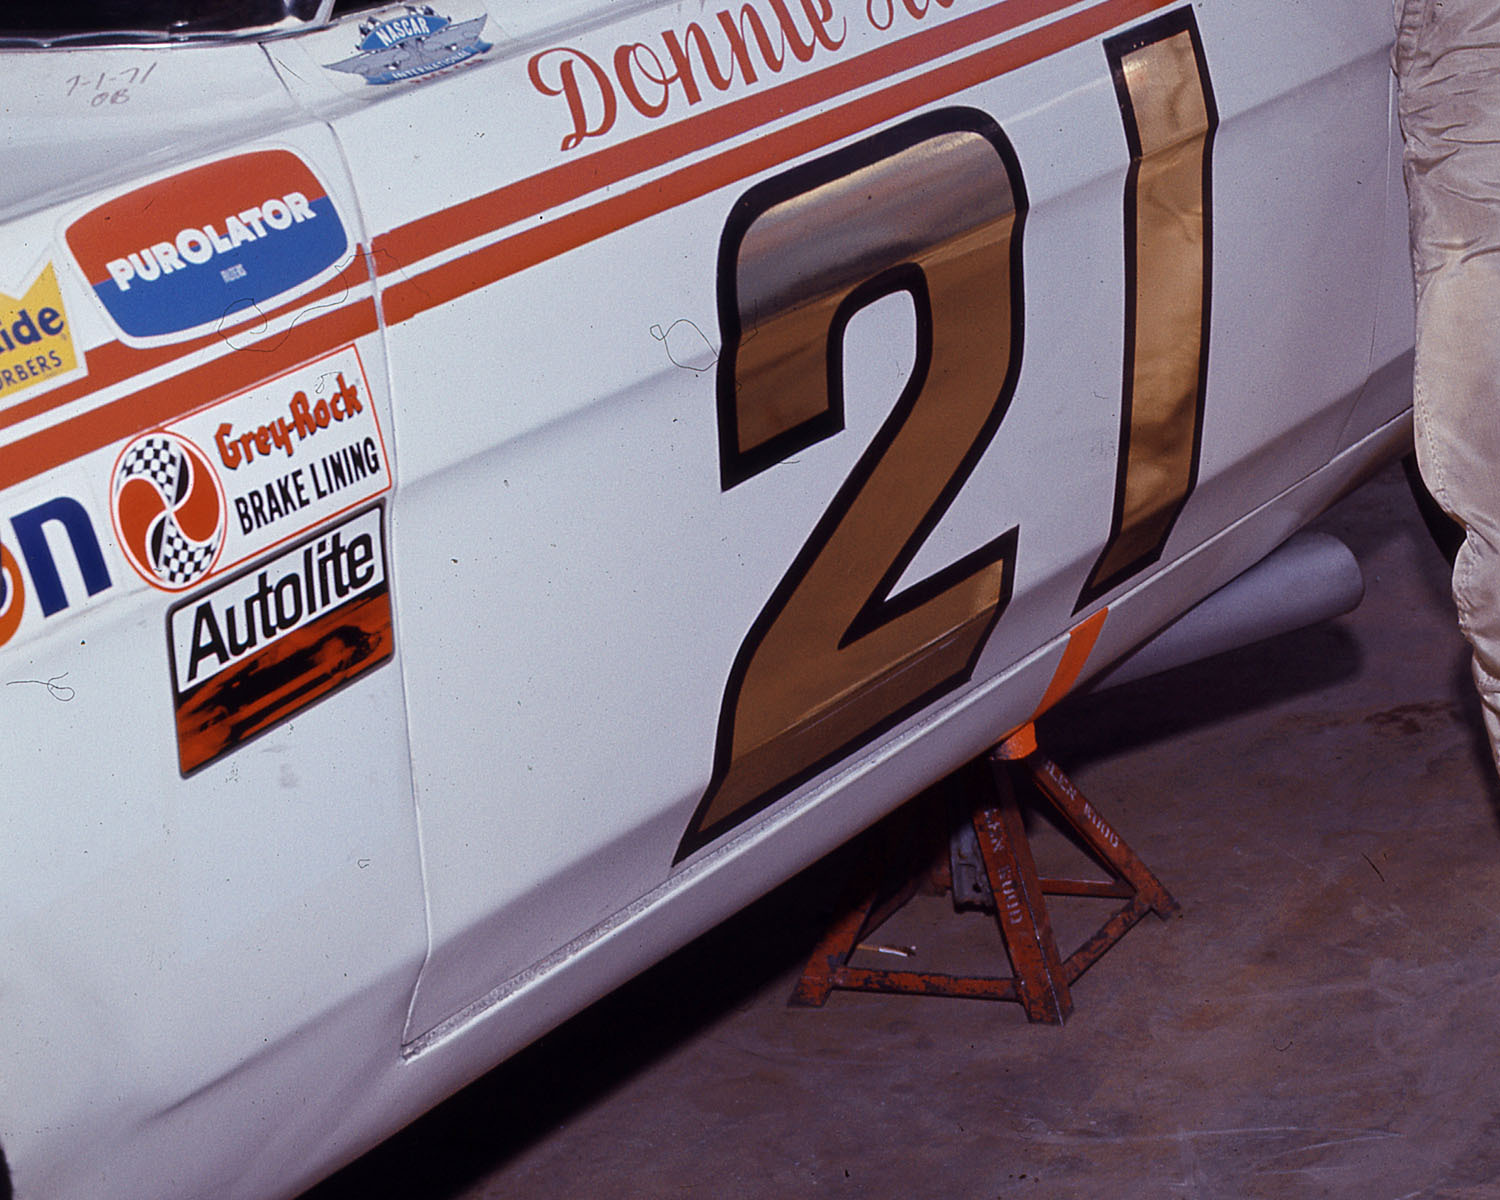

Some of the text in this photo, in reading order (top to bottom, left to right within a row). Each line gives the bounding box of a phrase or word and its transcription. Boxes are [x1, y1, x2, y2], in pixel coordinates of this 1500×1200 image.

[66, 61, 158, 96] 7-1-71
[375, 16, 430, 47] NASCAR
[105, 191, 317, 292] PUROLATOR
[0, 307, 64, 353] ide
[0, 350, 62, 390] RBERS
[214, 372, 363, 471] Grey-Rock
[672, 4, 1219, 868] 21
[234, 437, 380, 535] BRAKE LINING
[188, 532, 375, 683] Autolite
